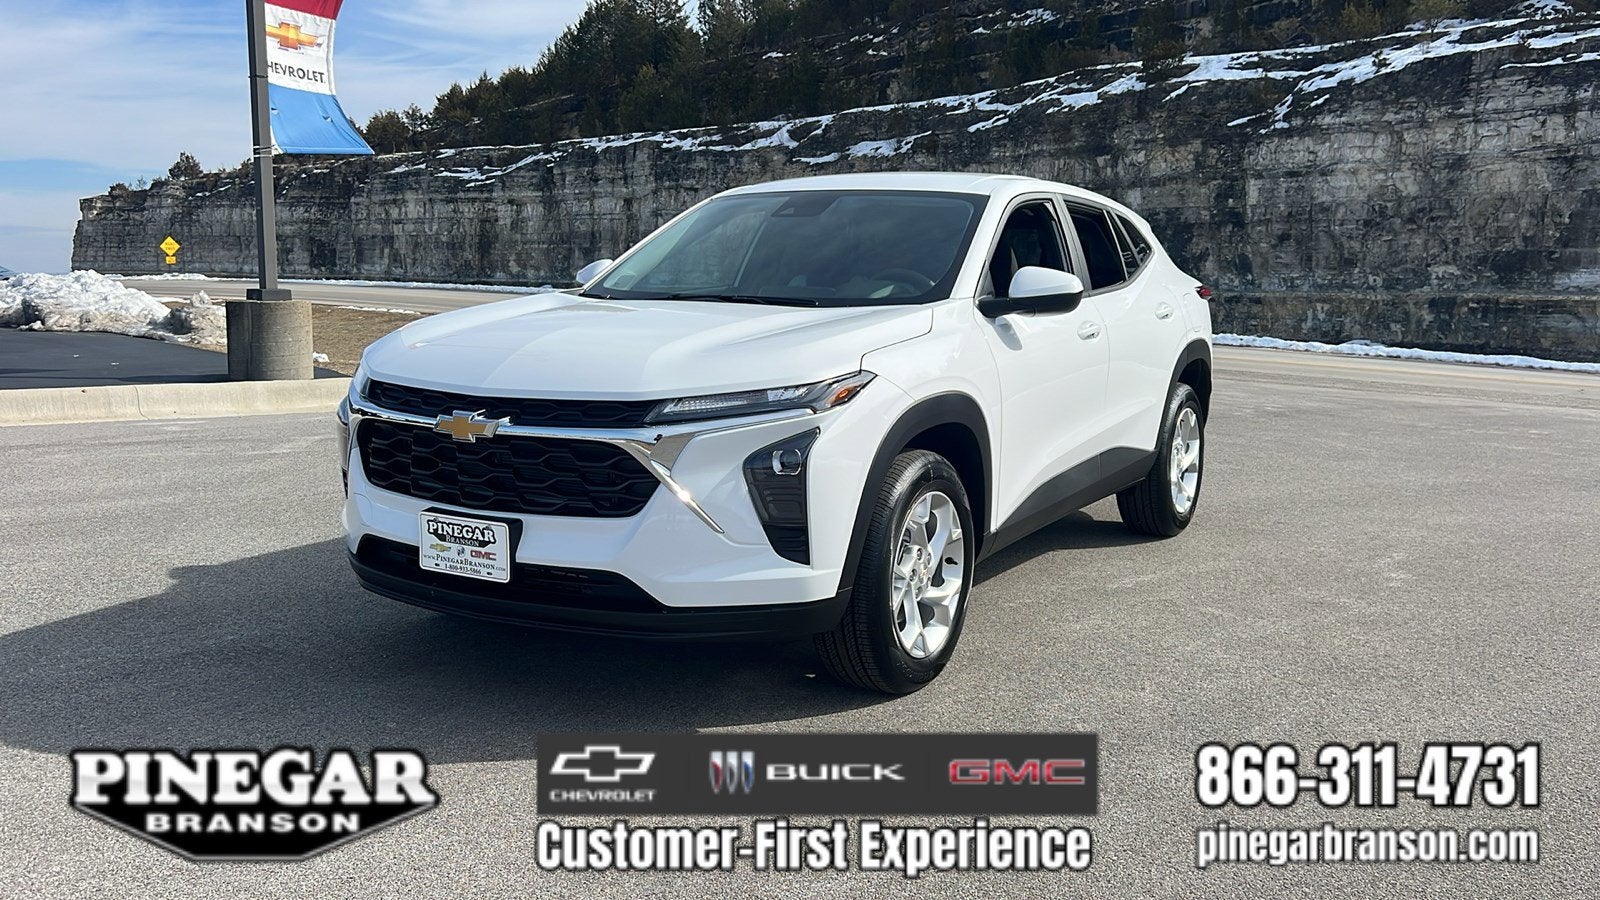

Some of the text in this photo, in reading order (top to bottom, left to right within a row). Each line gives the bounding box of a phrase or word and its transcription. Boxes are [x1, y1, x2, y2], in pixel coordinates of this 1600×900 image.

[267, 61, 325, 83] HEVROLET
[428, 521, 495, 542] PINEGAR
[445, 535, 480, 547] BRANSON
[470, 549, 497, 561] GMC
